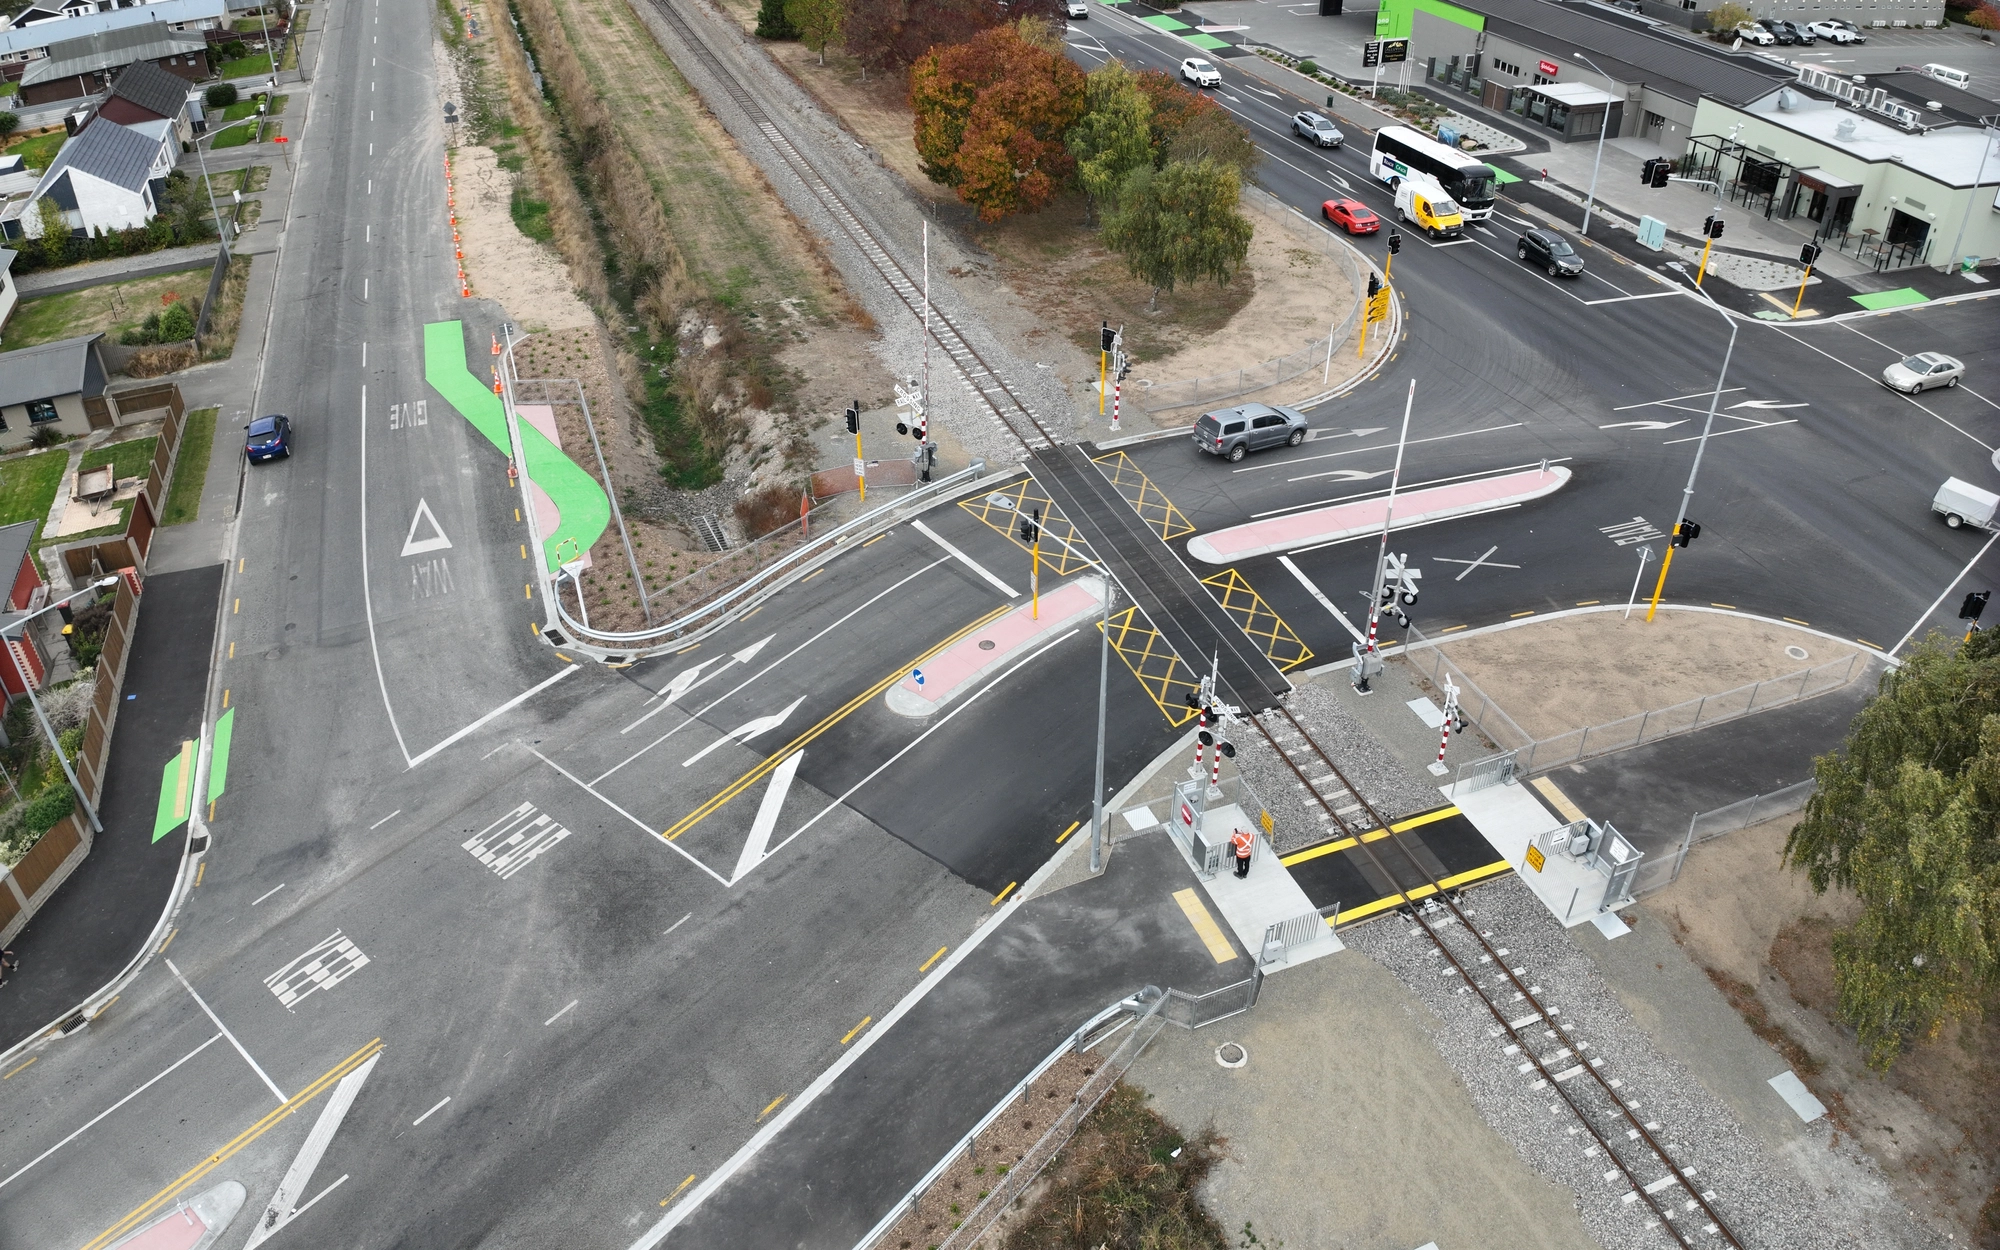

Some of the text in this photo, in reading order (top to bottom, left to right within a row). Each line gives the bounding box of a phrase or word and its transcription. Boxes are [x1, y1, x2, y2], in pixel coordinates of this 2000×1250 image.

[390, 400, 428, 430] GIVE
[1599, 516, 1666, 546] RAIL
[411, 557, 455, 601] WAY
[1215, 698, 1237, 722] CROSSING
[461, 801, 572, 880] CLEAR
[263, 928, 371, 1009] KEEP
